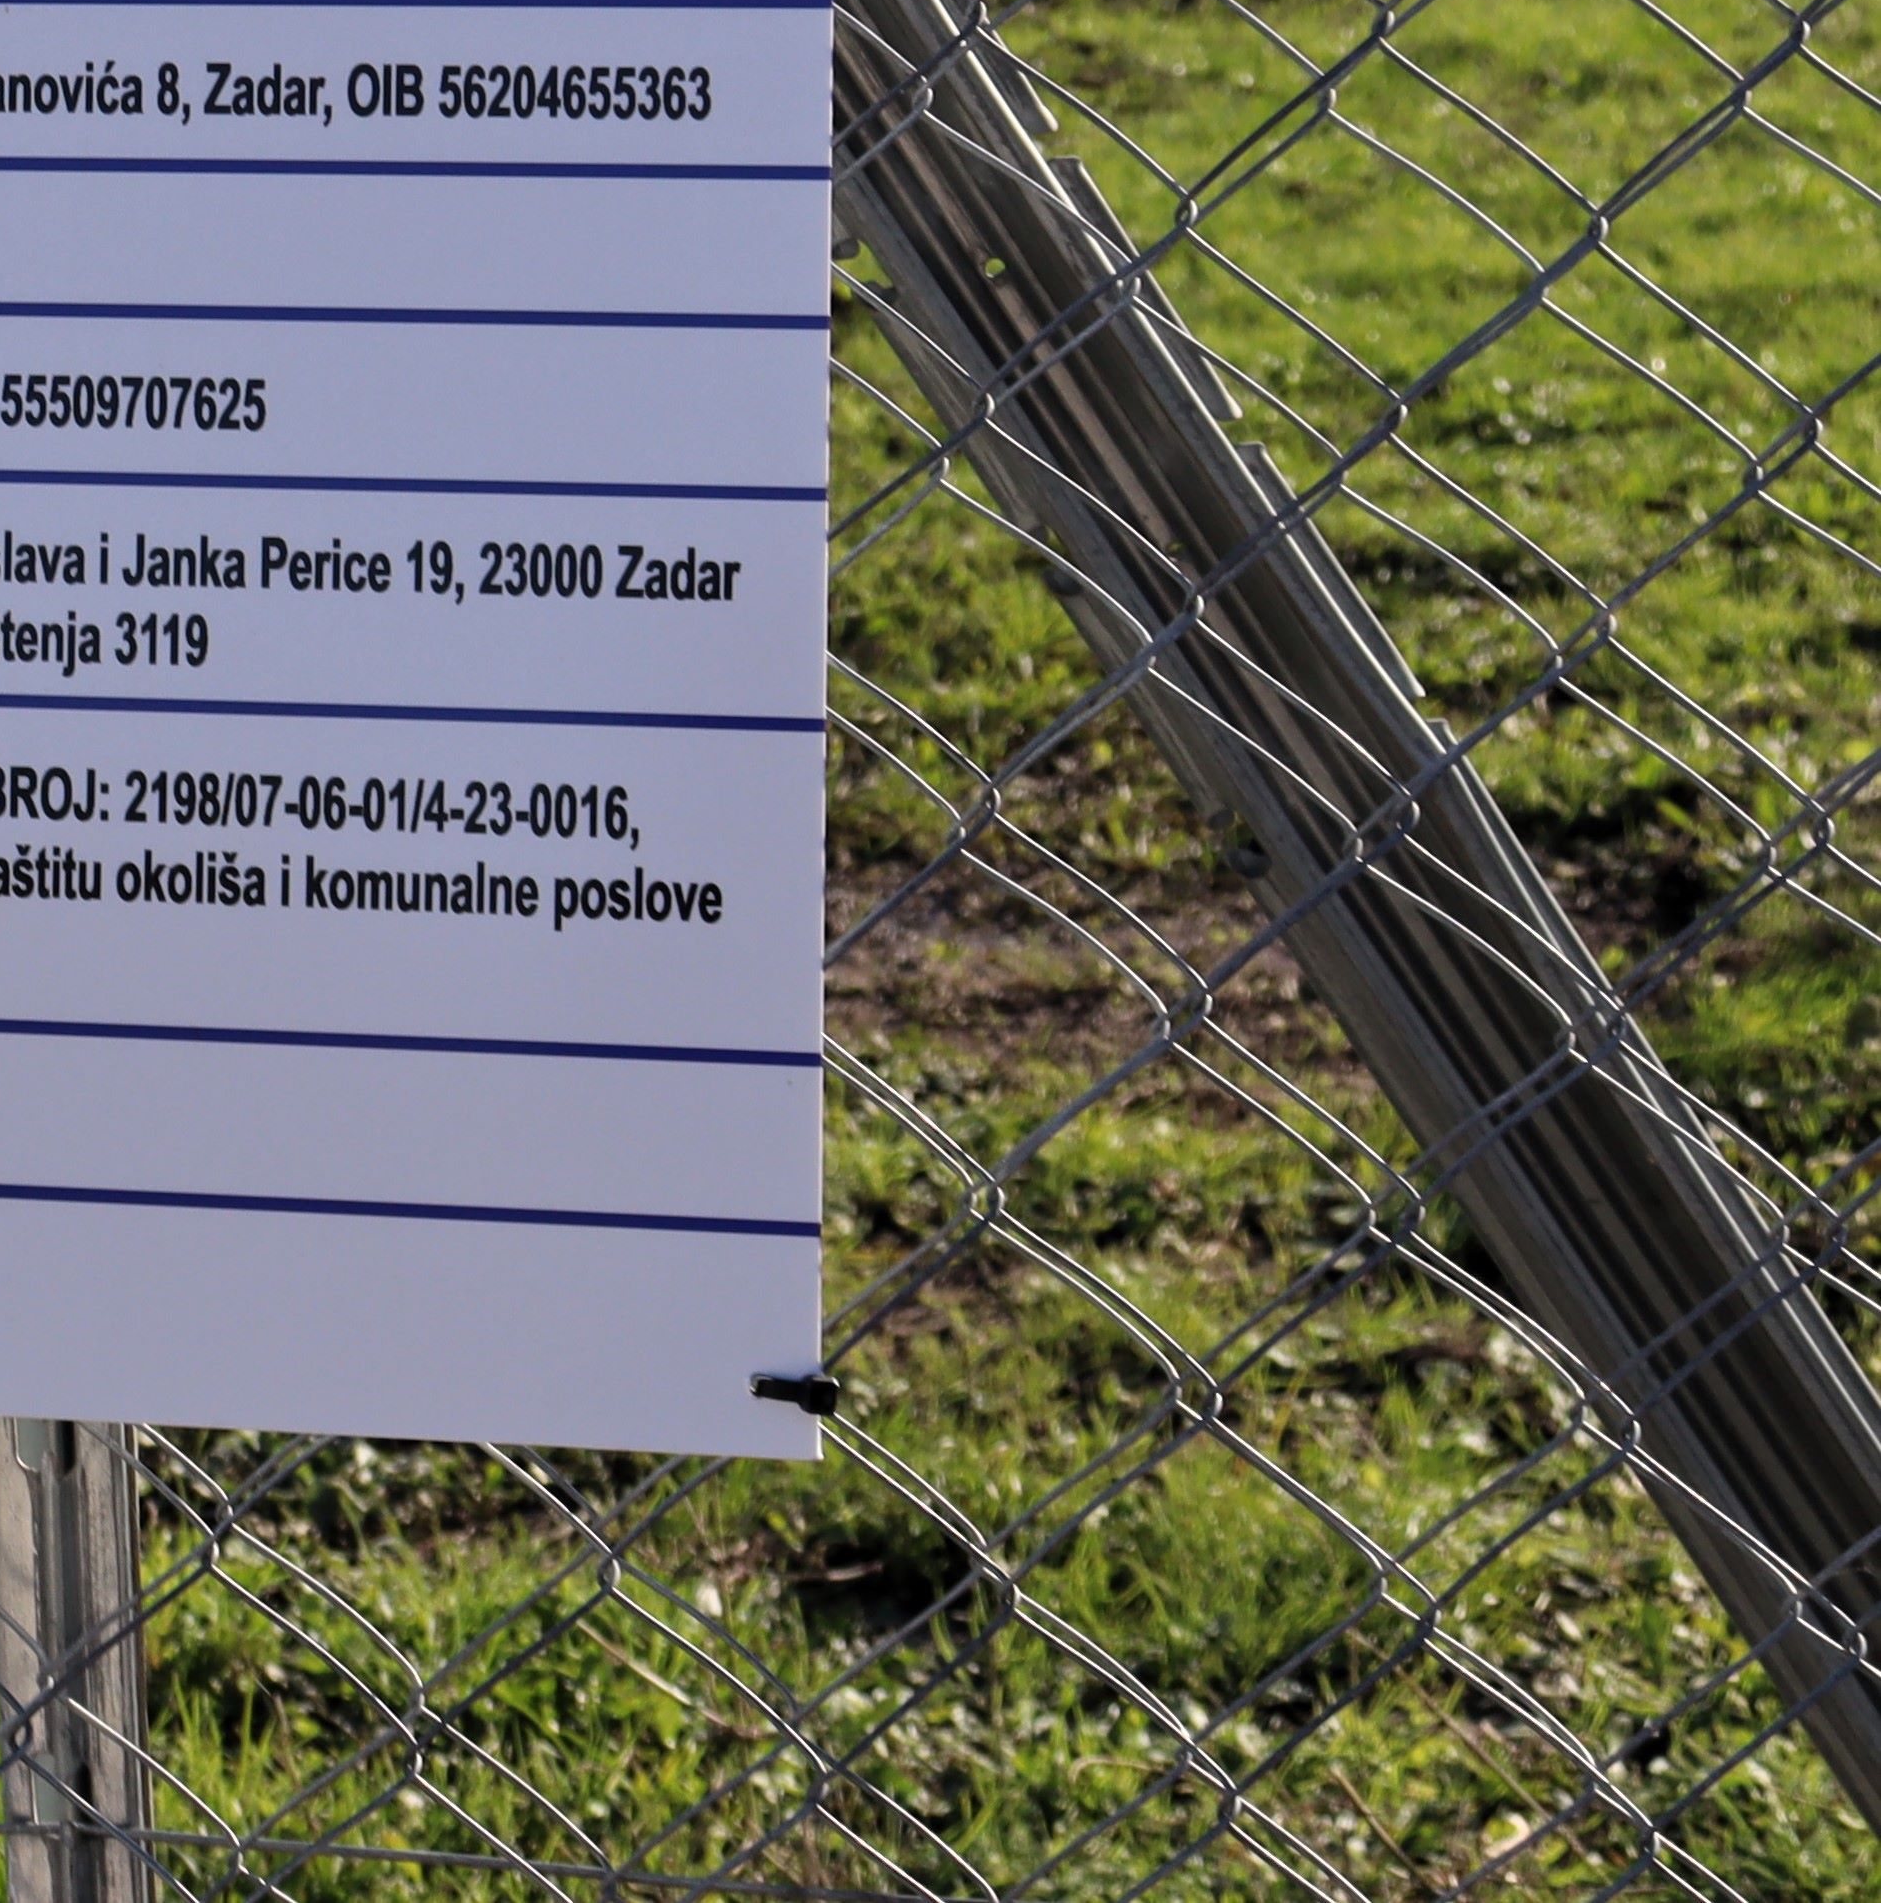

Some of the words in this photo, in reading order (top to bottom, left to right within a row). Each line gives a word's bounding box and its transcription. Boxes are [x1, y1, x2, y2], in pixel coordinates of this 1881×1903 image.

[157, 62, 191, 126] 8,
[203, 62, 332, 127] Zadar,
[347, 63, 425, 118] OIB
[438, 65, 712, 121] 56204655363
[0, 374, 266, 432] 55509707625
[100, 532, 109, 585] i
[122, 533, 246, 589] Janka
[261, 536, 391, 593] Perice
[407, 540, 465, 605] 19,
[479, 542, 603, 599] 23000
[615, 545, 741, 602] Zadar
[114, 612, 209, 667] 3119
[124, 770, 639, 851] 2198/07-06-01/4-23-0016,
[116, 849, 266, 907] okoliša
[281, 854, 290, 907] i
[305, 855, 539, 917] komunalne
[554, 866, 723, 932] poslove
